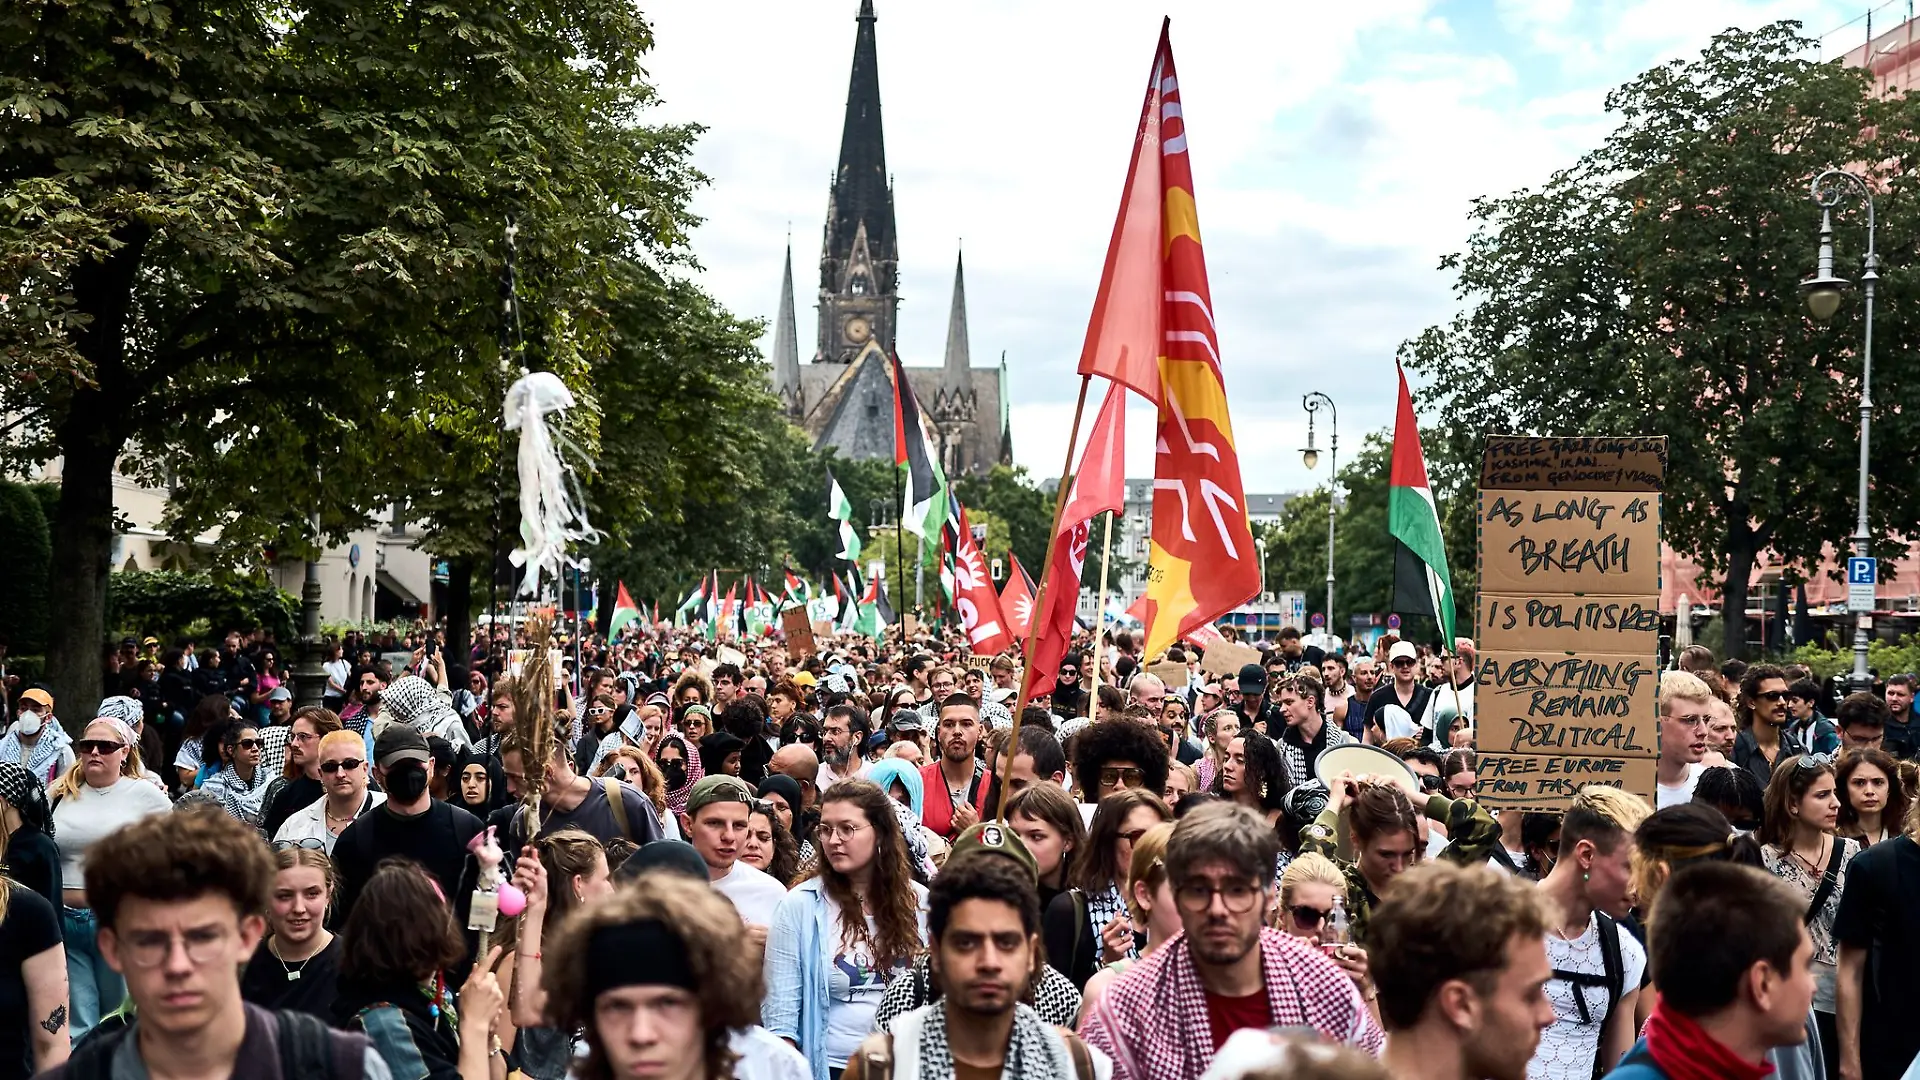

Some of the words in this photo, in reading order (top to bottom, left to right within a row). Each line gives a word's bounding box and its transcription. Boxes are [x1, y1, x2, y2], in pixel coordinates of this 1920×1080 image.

[1487, 439, 1545, 456] FREE
[1487, 472, 1540, 486] FROM
[1486, 496, 1524, 528] AS
[1532, 495, 1616, 530] LONG
[1621, 497, 1649, 523] AS
[1508, 532, 1630, 576] BREATH
[1854, 561, 1870, 581] P
[1488, 601, 1517, 630] IS
[969, 657, 991, 667] FUCK
[1476, 657, 1653, 696] EVERYTHING
[1527, 690, 1630, 718] REMAINS
[1508, 717, 1652, 754] POLITICAL.
[1477, 757, 1540, 777] FREE
[1543, 757, 1626, 774] EUROPE
[1477, 779, 1528, 795] FROM
[1536, 778, 1623, 797] FASC
